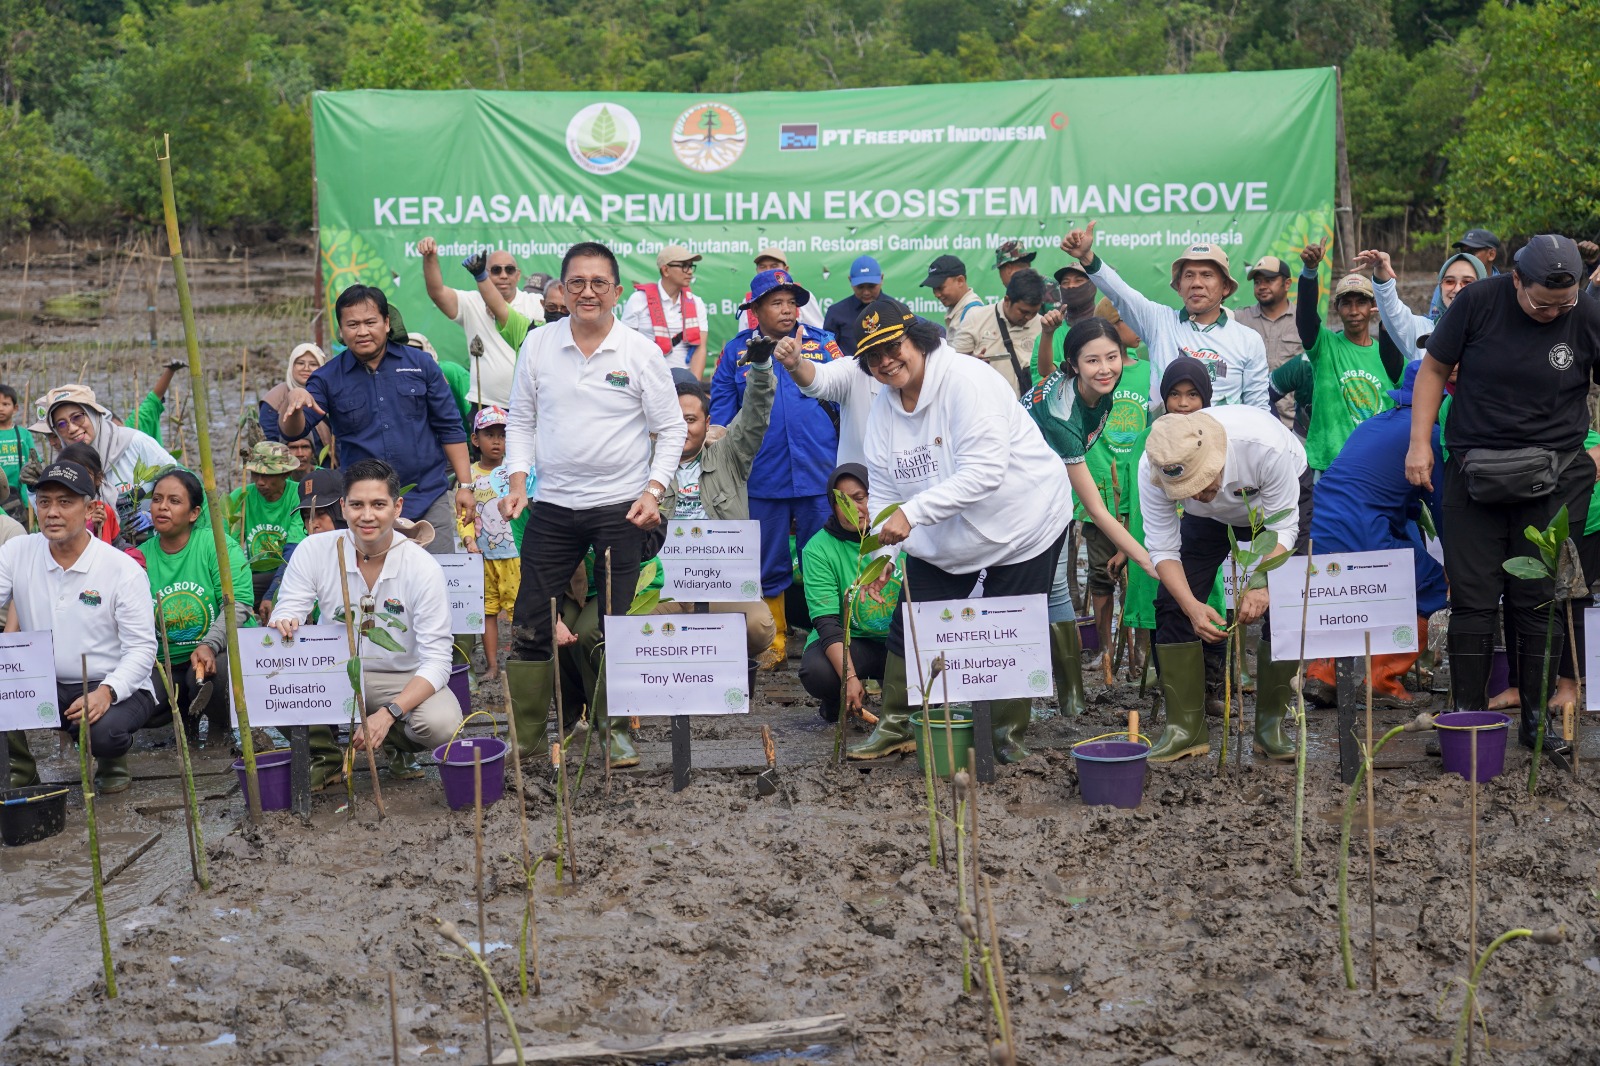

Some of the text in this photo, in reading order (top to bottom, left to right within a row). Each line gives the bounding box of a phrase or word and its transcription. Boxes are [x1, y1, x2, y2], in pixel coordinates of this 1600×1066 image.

[822, 125, 1046, 146] PT FREEPORT INDONESIA
[373, 181, 1268, 225] KERJASAMA PEMULIHAN EKOSISTEM MANGROVE
[405, 239, 494, 257] Kenterian
[499, 238, 574, 259] Lingkunga
[636, 238, 664, 254] dan
[811, 235, 883, 252] Restorasi
[887, 234, 949, 250] Gambut
[952, 233, 982, 249] dan
[1096, 230, 1162, 249] Freeport
[1166, 228, 1243, 246] Indonesia
[663, 545, 744, 555] DIR. PPHSDA IKN
[684, 567, 721, 579] Pungky
[673, 579, 732, 591] Widiaryanto
[1350, 583, 1387, 595] BRGM
[1319, 613, 1369, 626] Hartono
[936, 628, 1018, 643] MENTERI LHK
[635, 645, 717, 657] PRESDIR PTFI
[255, 656, 336, 669] KOMISI IV DPR
[943, 657, 1016, 671] Siti Nurbaya
[640, 672, 714, 686] Tony Wenas
[962, 672, 998, 685] Bakar
[269, 682, 326, 695] Budisatrio
[265, 698, 332, 712] Djiwandono
